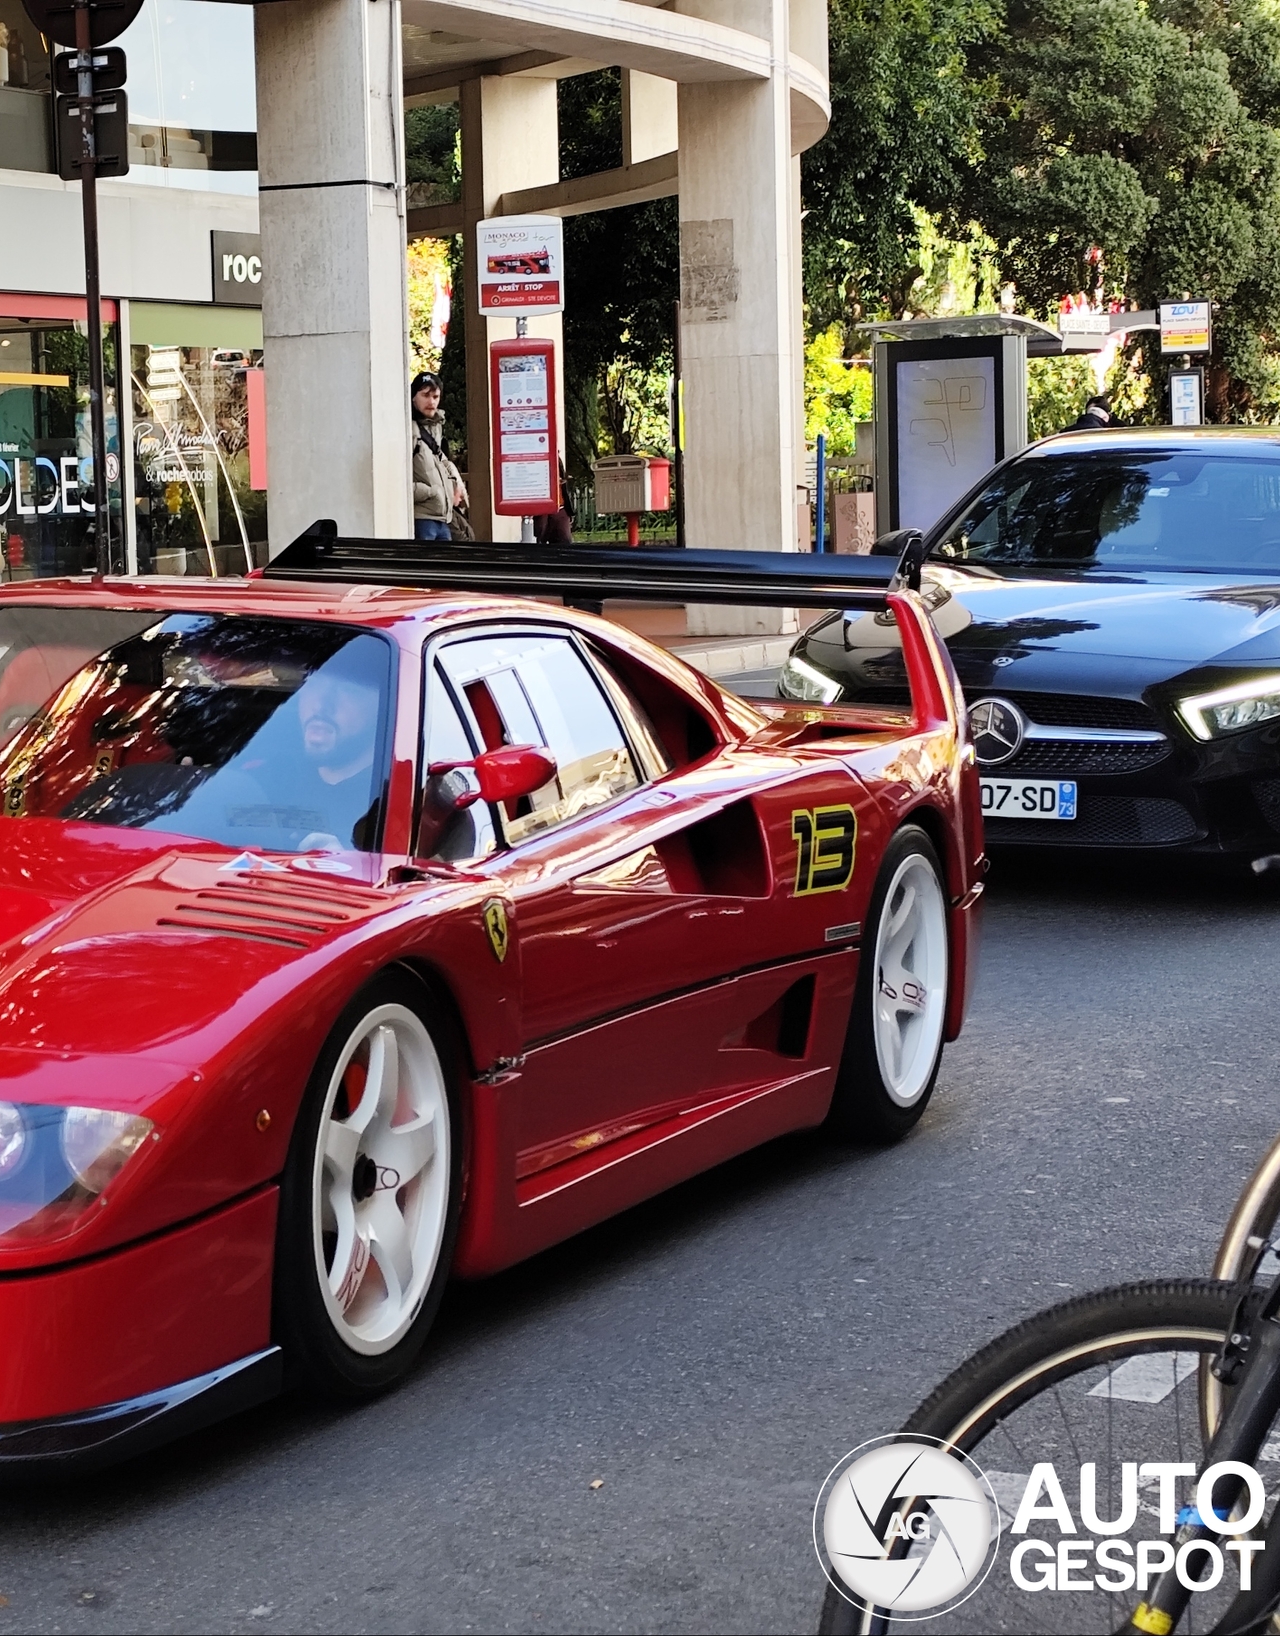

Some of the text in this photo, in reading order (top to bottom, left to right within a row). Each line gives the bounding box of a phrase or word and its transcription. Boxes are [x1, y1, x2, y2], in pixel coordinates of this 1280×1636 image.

[222, 253, 262, 284] roc
[497, 282, 543, 292] ARRÊT STOP
[1170, 304, 1199, 316] ZOU!
[1061, 318, 1075, 329] PLACE
[145, 465, 154, 483] &
[980, 784, 1056, 813] 07-SD
[1059, 802, 1074, 815] 73
[792, 803, 858, 897] 13
